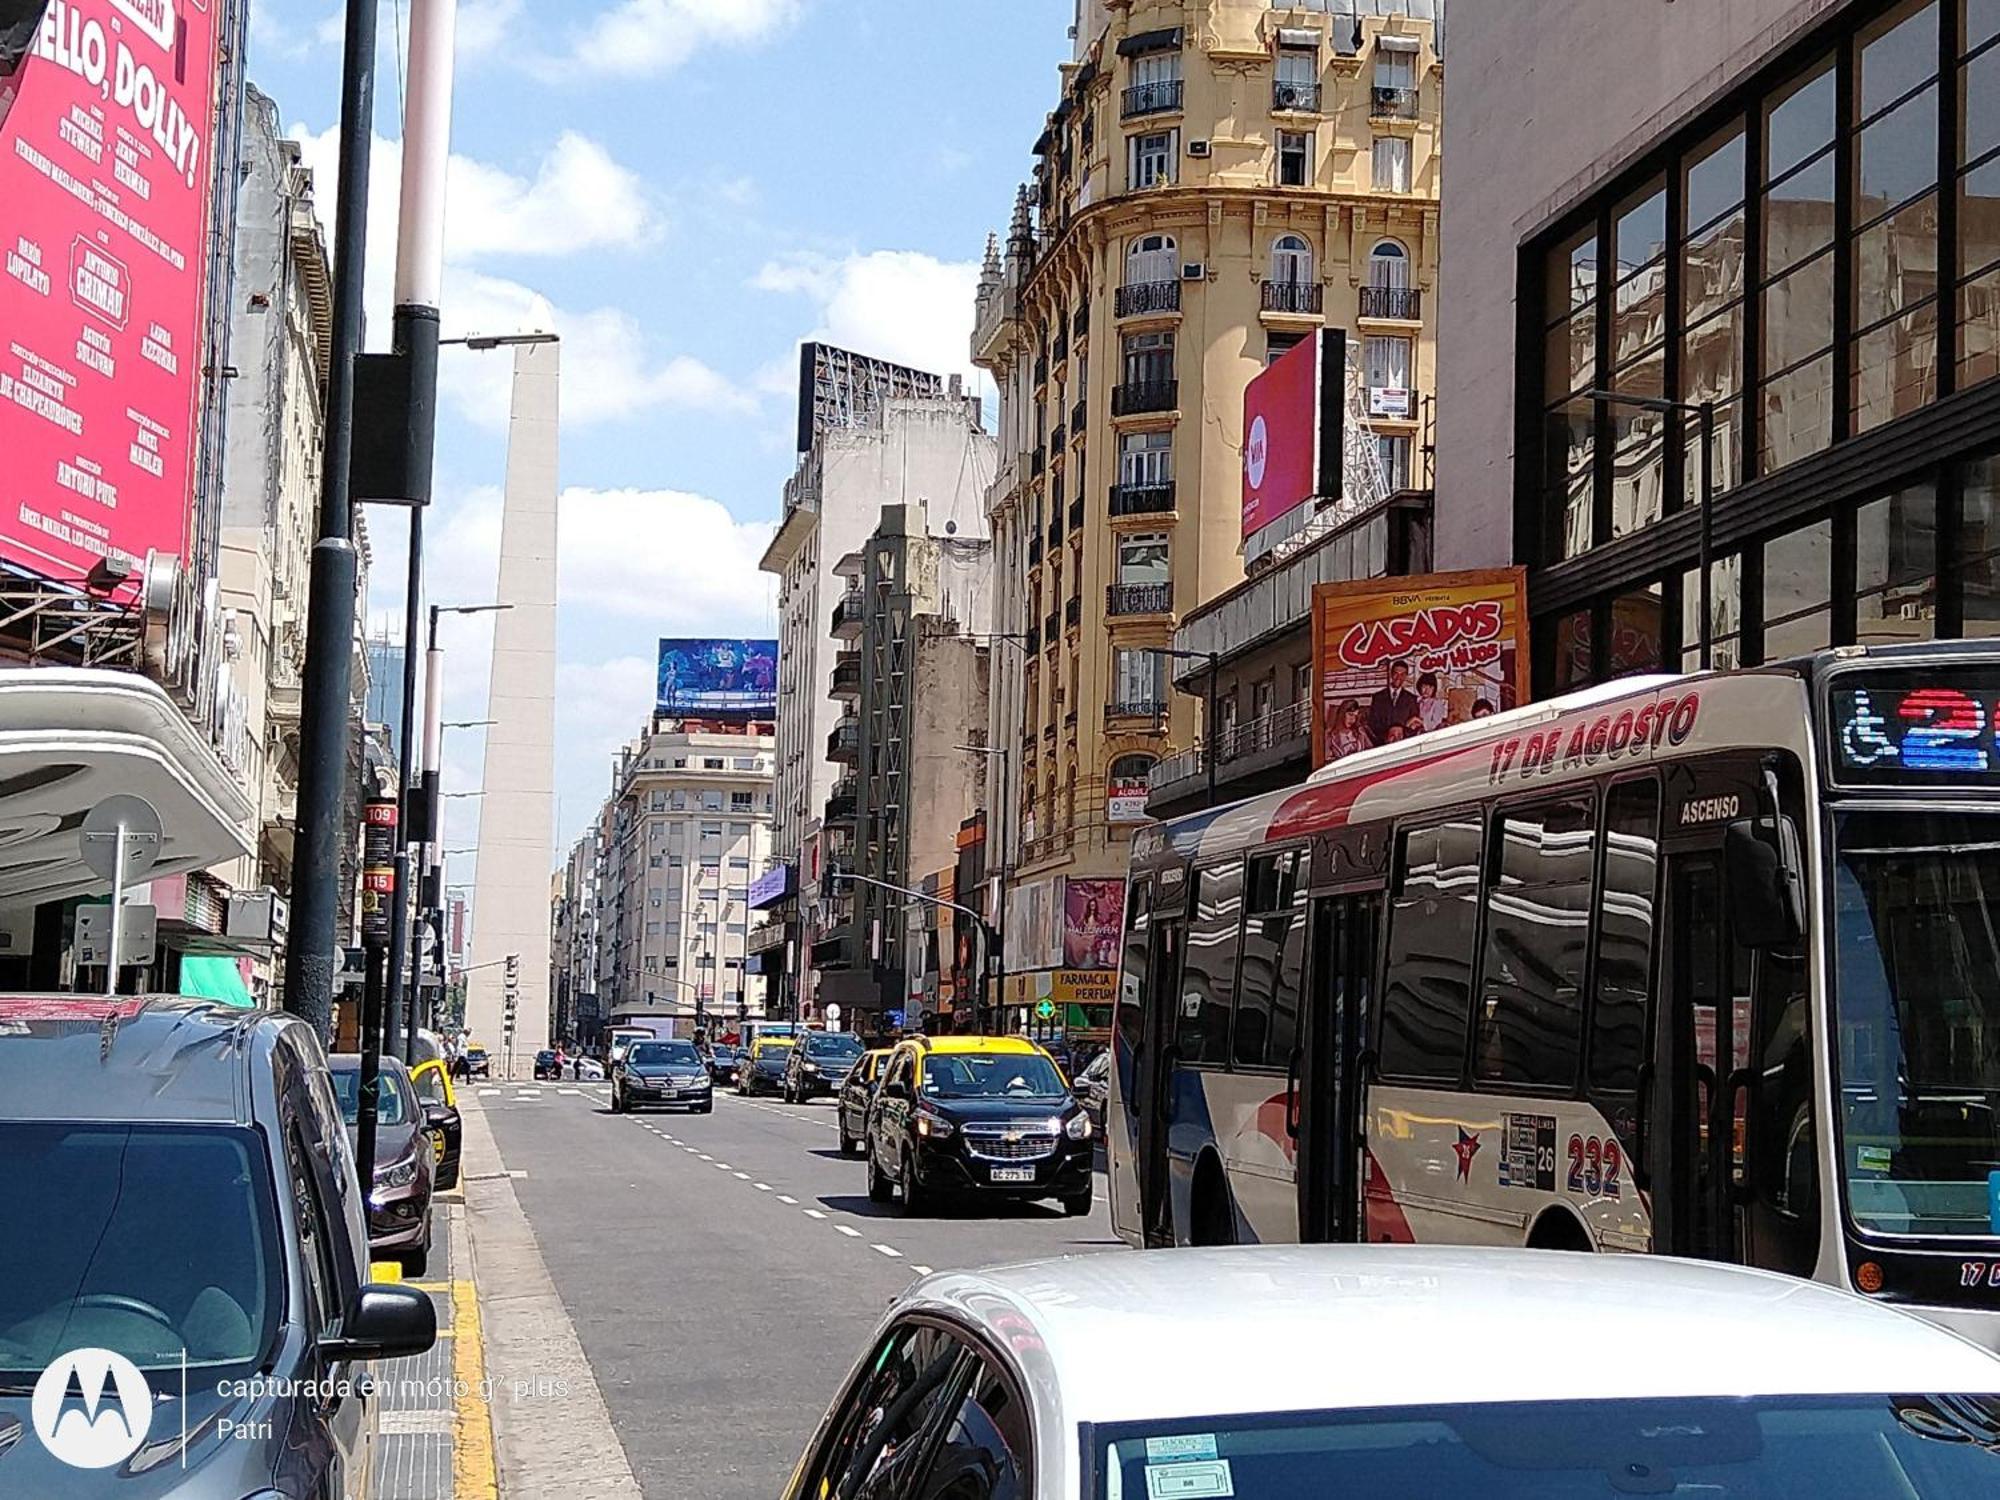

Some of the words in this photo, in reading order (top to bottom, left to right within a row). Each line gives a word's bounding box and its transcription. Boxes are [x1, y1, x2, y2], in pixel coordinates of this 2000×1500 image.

[31, 0, 109, 100] ELLO,
[114, 41, 200, 189] DOLLY!
[60, 117, 102, 165] STEWART
[6, 250, 50, 296] LOPILATO
[77, 266, 124, 319] GRIMAU
[76, 340, 115, 378] SULLIVAN
[56, 461, 95, 499] ARTURO
[95, 480, 117, 509] PUIG
[1392, 595, 1421, 605] BBVA
[1340, 602, 1501, 668] CASADOS
[1449, 641, 1501, 671] HIJOS
[1489, 736, 1521, 786] 17
[1520, 727, 1563, 779] DE
[1562, 692, 1700, 771] AGOSTO
[1899, 689, 2000, 770] 2
[368, 809, 391, 821] 109
[1681, 795, 1740, 824] ASCENSO
[367, 875, 388, 888] 115
[1067, 926, 1119, 935] HALLOWEEN
[1060, 973, 1110, 985] FARMACIA
[1537, 1146, 1554, 1172] 26
[1568, 1133, 1621, 1199] 232
[1960, 1262, 1985, 1287] 17
